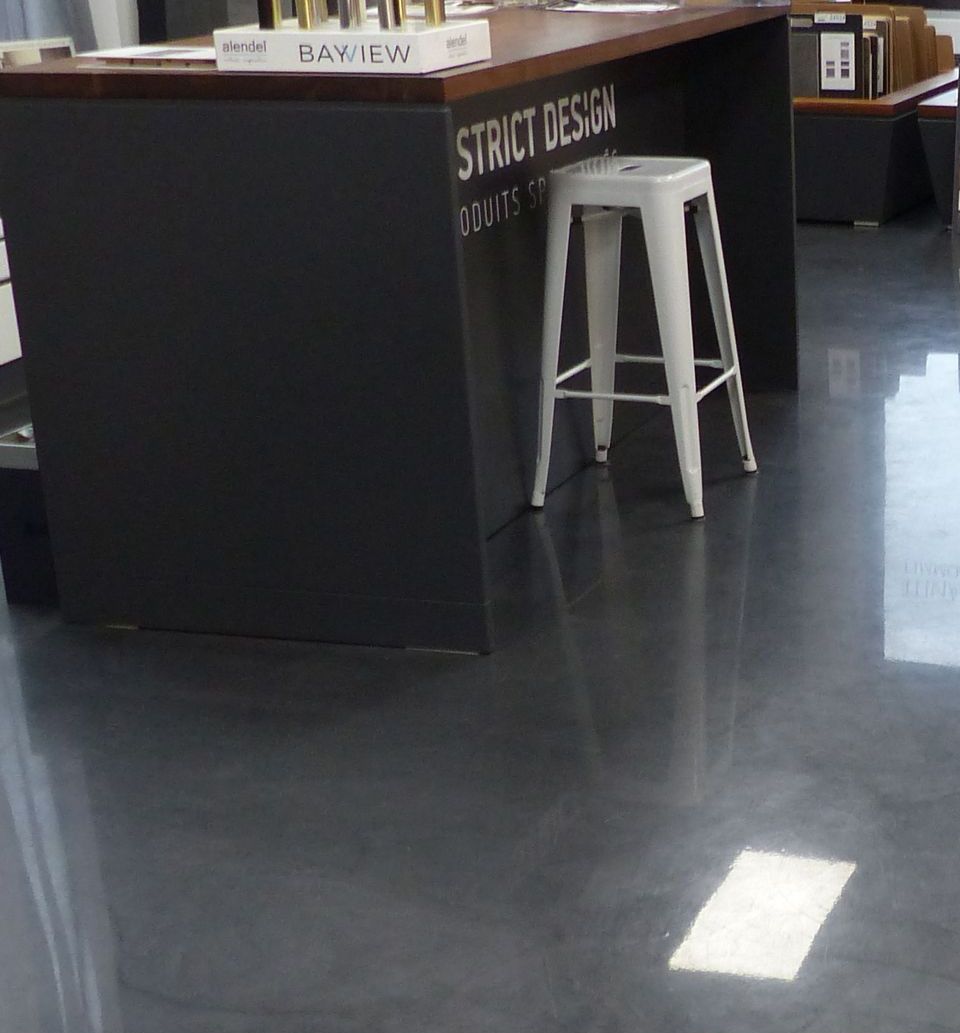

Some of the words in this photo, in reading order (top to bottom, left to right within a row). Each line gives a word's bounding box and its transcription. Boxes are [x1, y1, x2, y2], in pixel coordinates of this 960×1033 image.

[222, 40, 267, 53] alendel
[299, 44, 410, 64] BAYVIEW
[456, 106, 536, 181] STRICT
[543, 83, 617, 152] DESIGN
